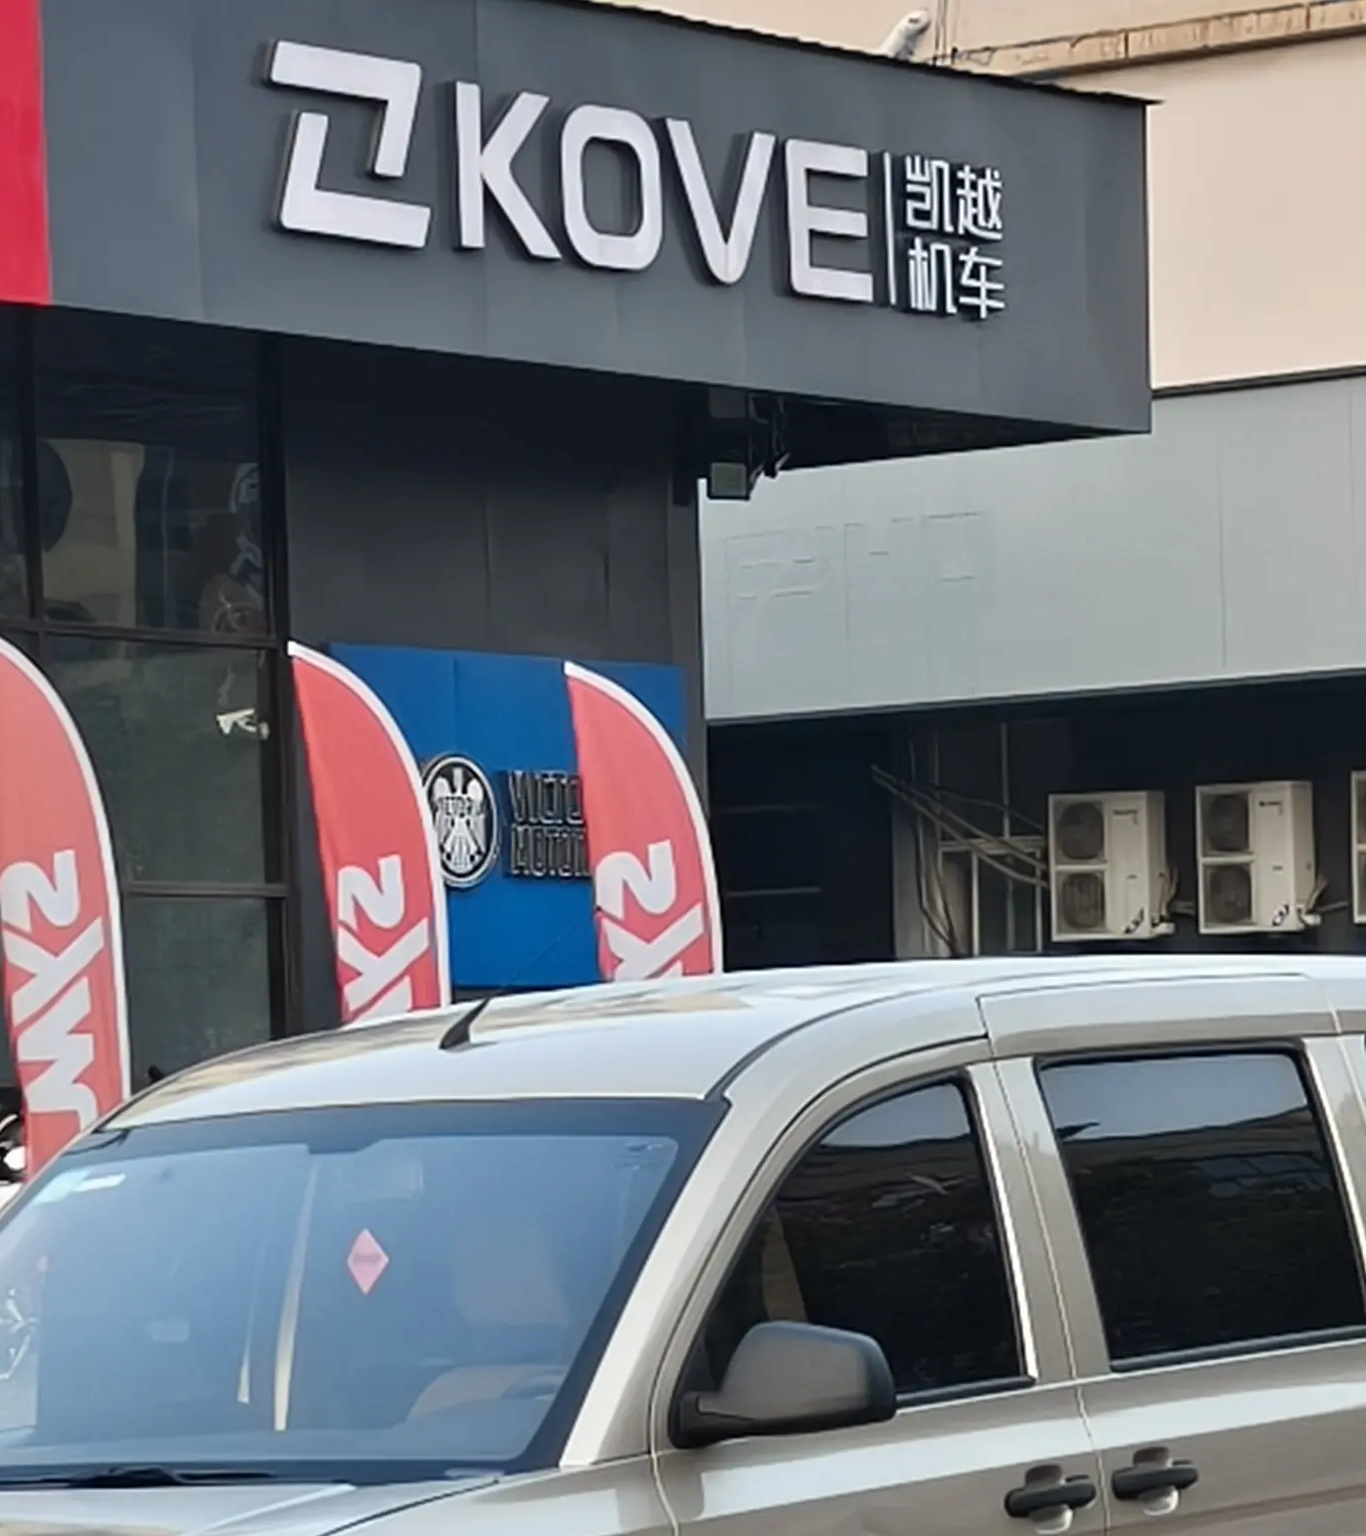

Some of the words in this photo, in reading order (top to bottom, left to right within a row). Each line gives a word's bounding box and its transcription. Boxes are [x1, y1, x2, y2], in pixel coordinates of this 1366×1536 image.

[452, 81, 875, 303] KOVE
[904, 154, 1003, 240] 凯越
[907, 236, 1006, 320] 机车
